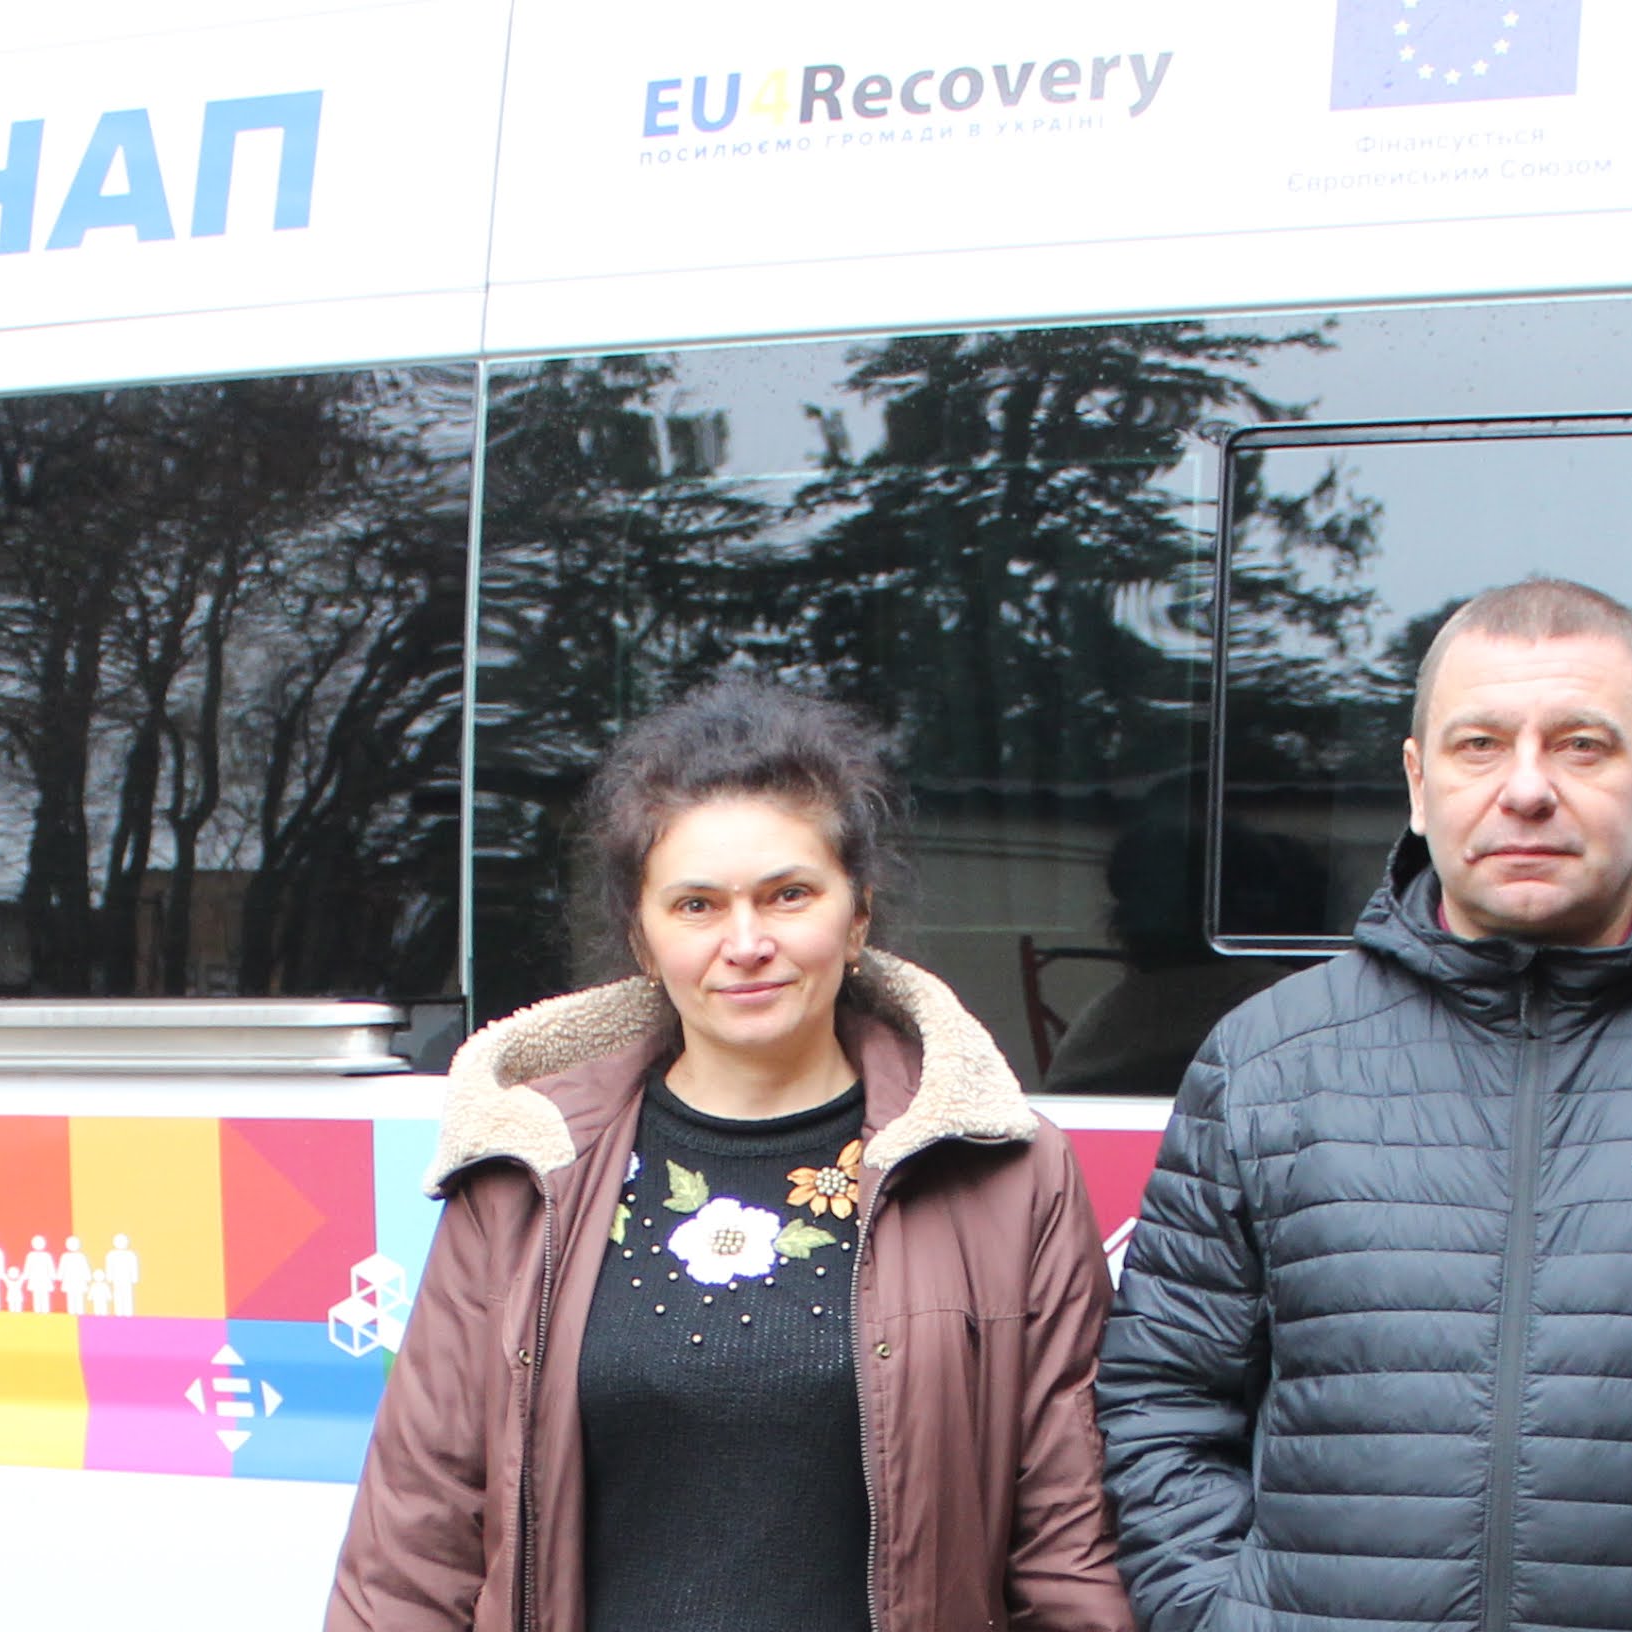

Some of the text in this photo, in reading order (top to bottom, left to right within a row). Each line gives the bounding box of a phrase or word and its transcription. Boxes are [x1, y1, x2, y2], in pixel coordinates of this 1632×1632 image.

[642, 51, 1174, 138] EU4Recovery
[639, 138, 812, 166] ПОСИЛЮЄМО
[825, 126, 954, 148] ГРОМАДИ
[969, 122, 982, 138] В
